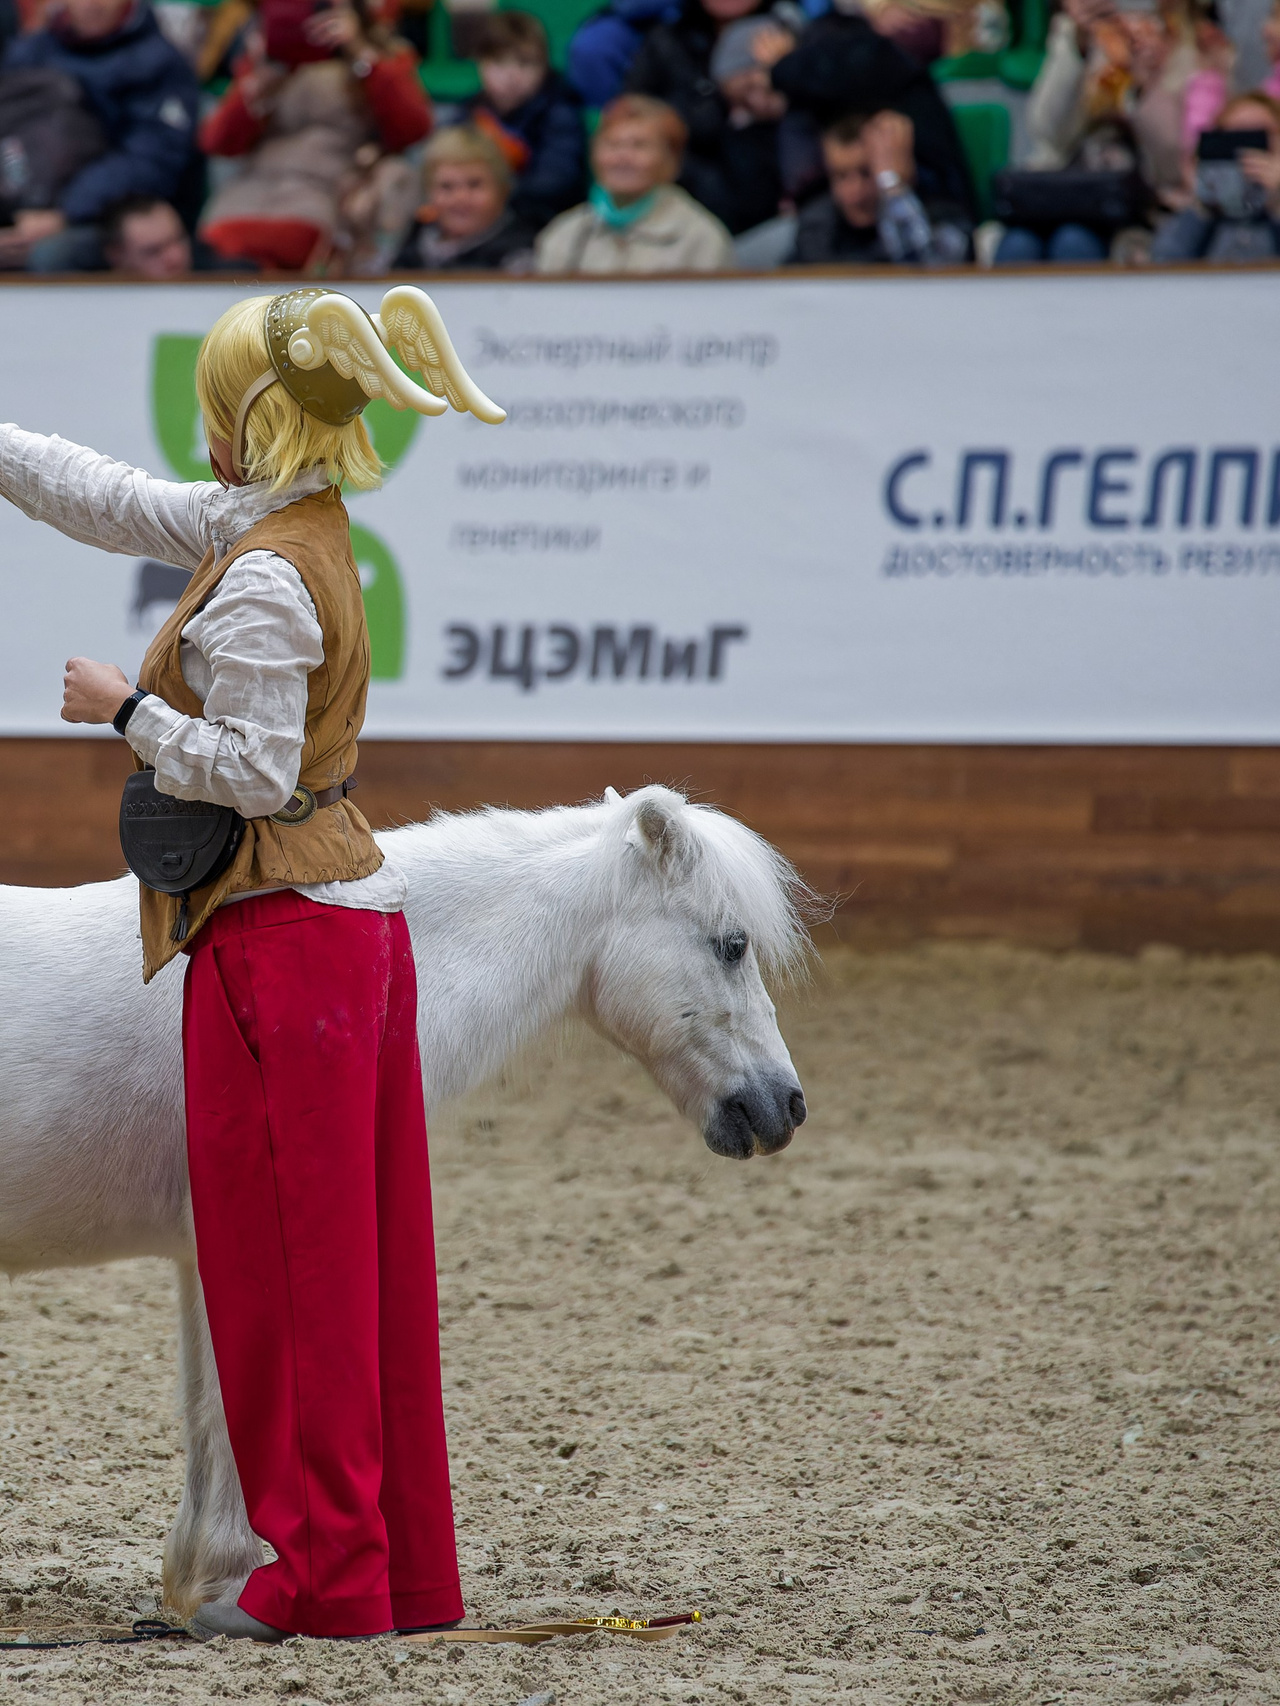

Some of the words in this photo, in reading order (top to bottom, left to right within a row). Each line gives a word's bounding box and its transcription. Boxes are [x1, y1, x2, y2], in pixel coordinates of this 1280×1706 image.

[680, 335, 779, 373] центр
[683, 461, 711, 491] и
[881, 542, 1170, 577] ДОСТОВЕРНОСТЬ
[442, 623, 750, 690] ЭЦЭМиГ
